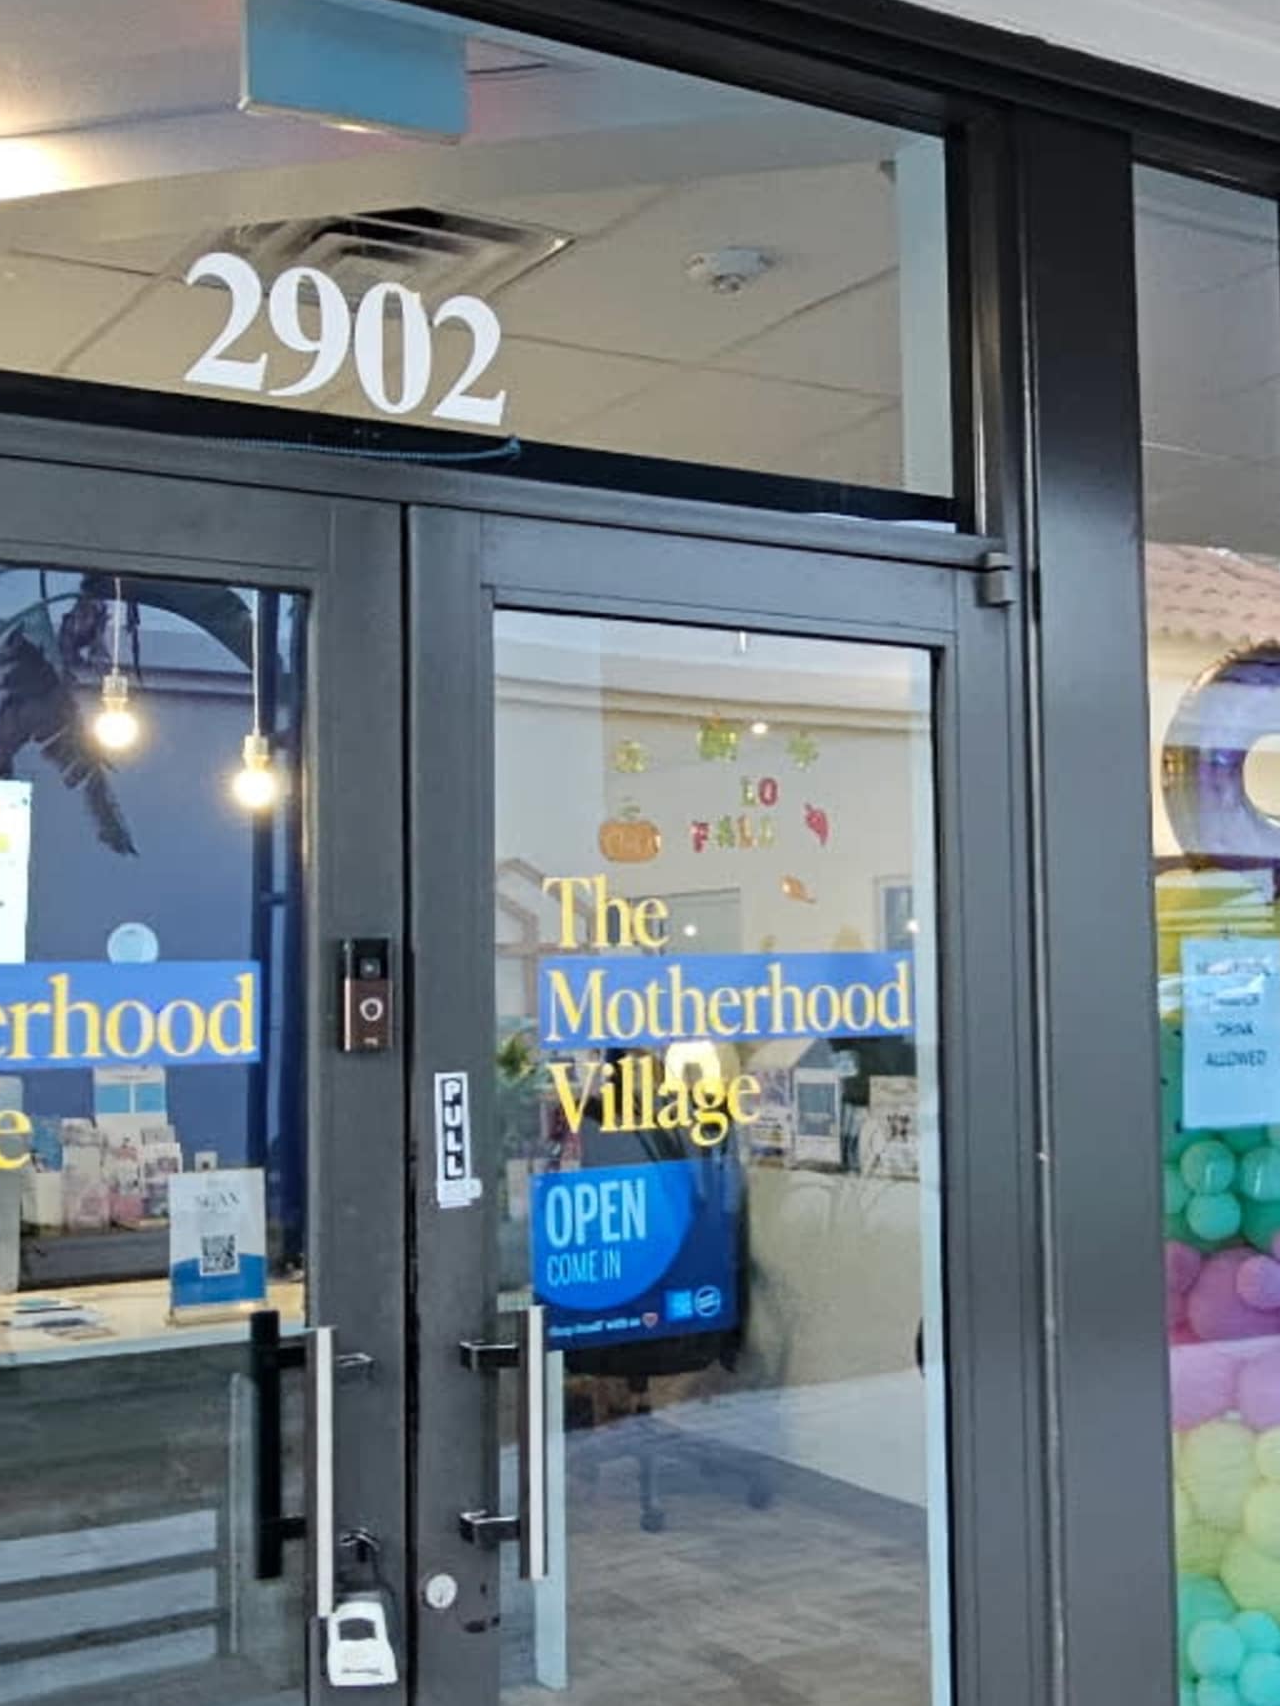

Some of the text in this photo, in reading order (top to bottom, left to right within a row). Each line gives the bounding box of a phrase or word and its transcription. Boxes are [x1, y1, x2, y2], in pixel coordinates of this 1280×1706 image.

[183, 251, 508, 426] 2902
[542, 873, 671, 949] The
[545, 959, 913, 1042] Motherhood
[1204, 1050, 1269, 1068] ALLOWED
[443, 1079, 464, 1178] PULL
[546, 1055, 762, 1147] Village
[545, 1177, 646, 1249] OPEN
[547, 1248, 621, 1288] COME IN
